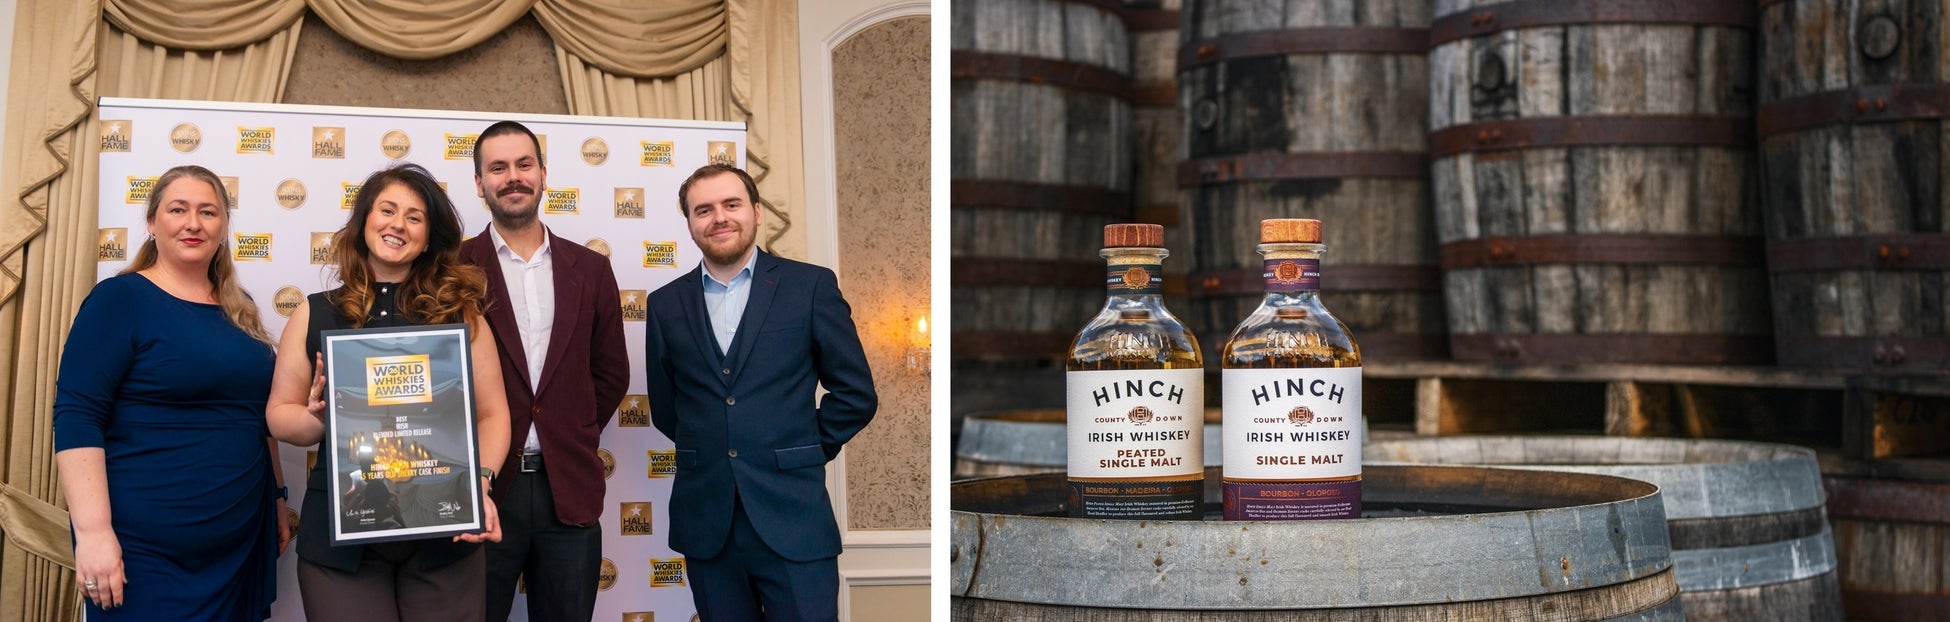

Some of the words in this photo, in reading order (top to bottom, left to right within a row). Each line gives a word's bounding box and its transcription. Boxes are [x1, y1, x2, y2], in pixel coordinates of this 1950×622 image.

[373, 364, 424, 377] WORLD
[374, 375, 425, 386] WHISKIES
[374, 384, 425, 396] AWARDS
[1092, 380, 1183, 407] HINCH
[1251, 378, 1344, 406] HINCH
[1088, 432, 1123, 442] IRISH
[1130, 430, 1190, 442] WHISKEY
[1247, 432, 1283, 442] IRISH
[1290, 430, 1350, 442] WHISKEY
[1117, 449, 1165, 458] PEATED
[410, 460, 438, 468] WHISKEY
[1100, 459, 1145, 468] SINGLE
[1151, 457, 1182, 467] MALT
[1256, 456, 1306, 466] SINGLE
[1312, 454, 1343, 465] MALT
[368, 471, 384, 479] YEARS
[418, 468, 432, 476] CASK
[1085, 486, 1118, 494] BOURBON
[1125, 486, 1160, 494] MADEIRA
[1260, 490, 1299, 498] BOURBON
